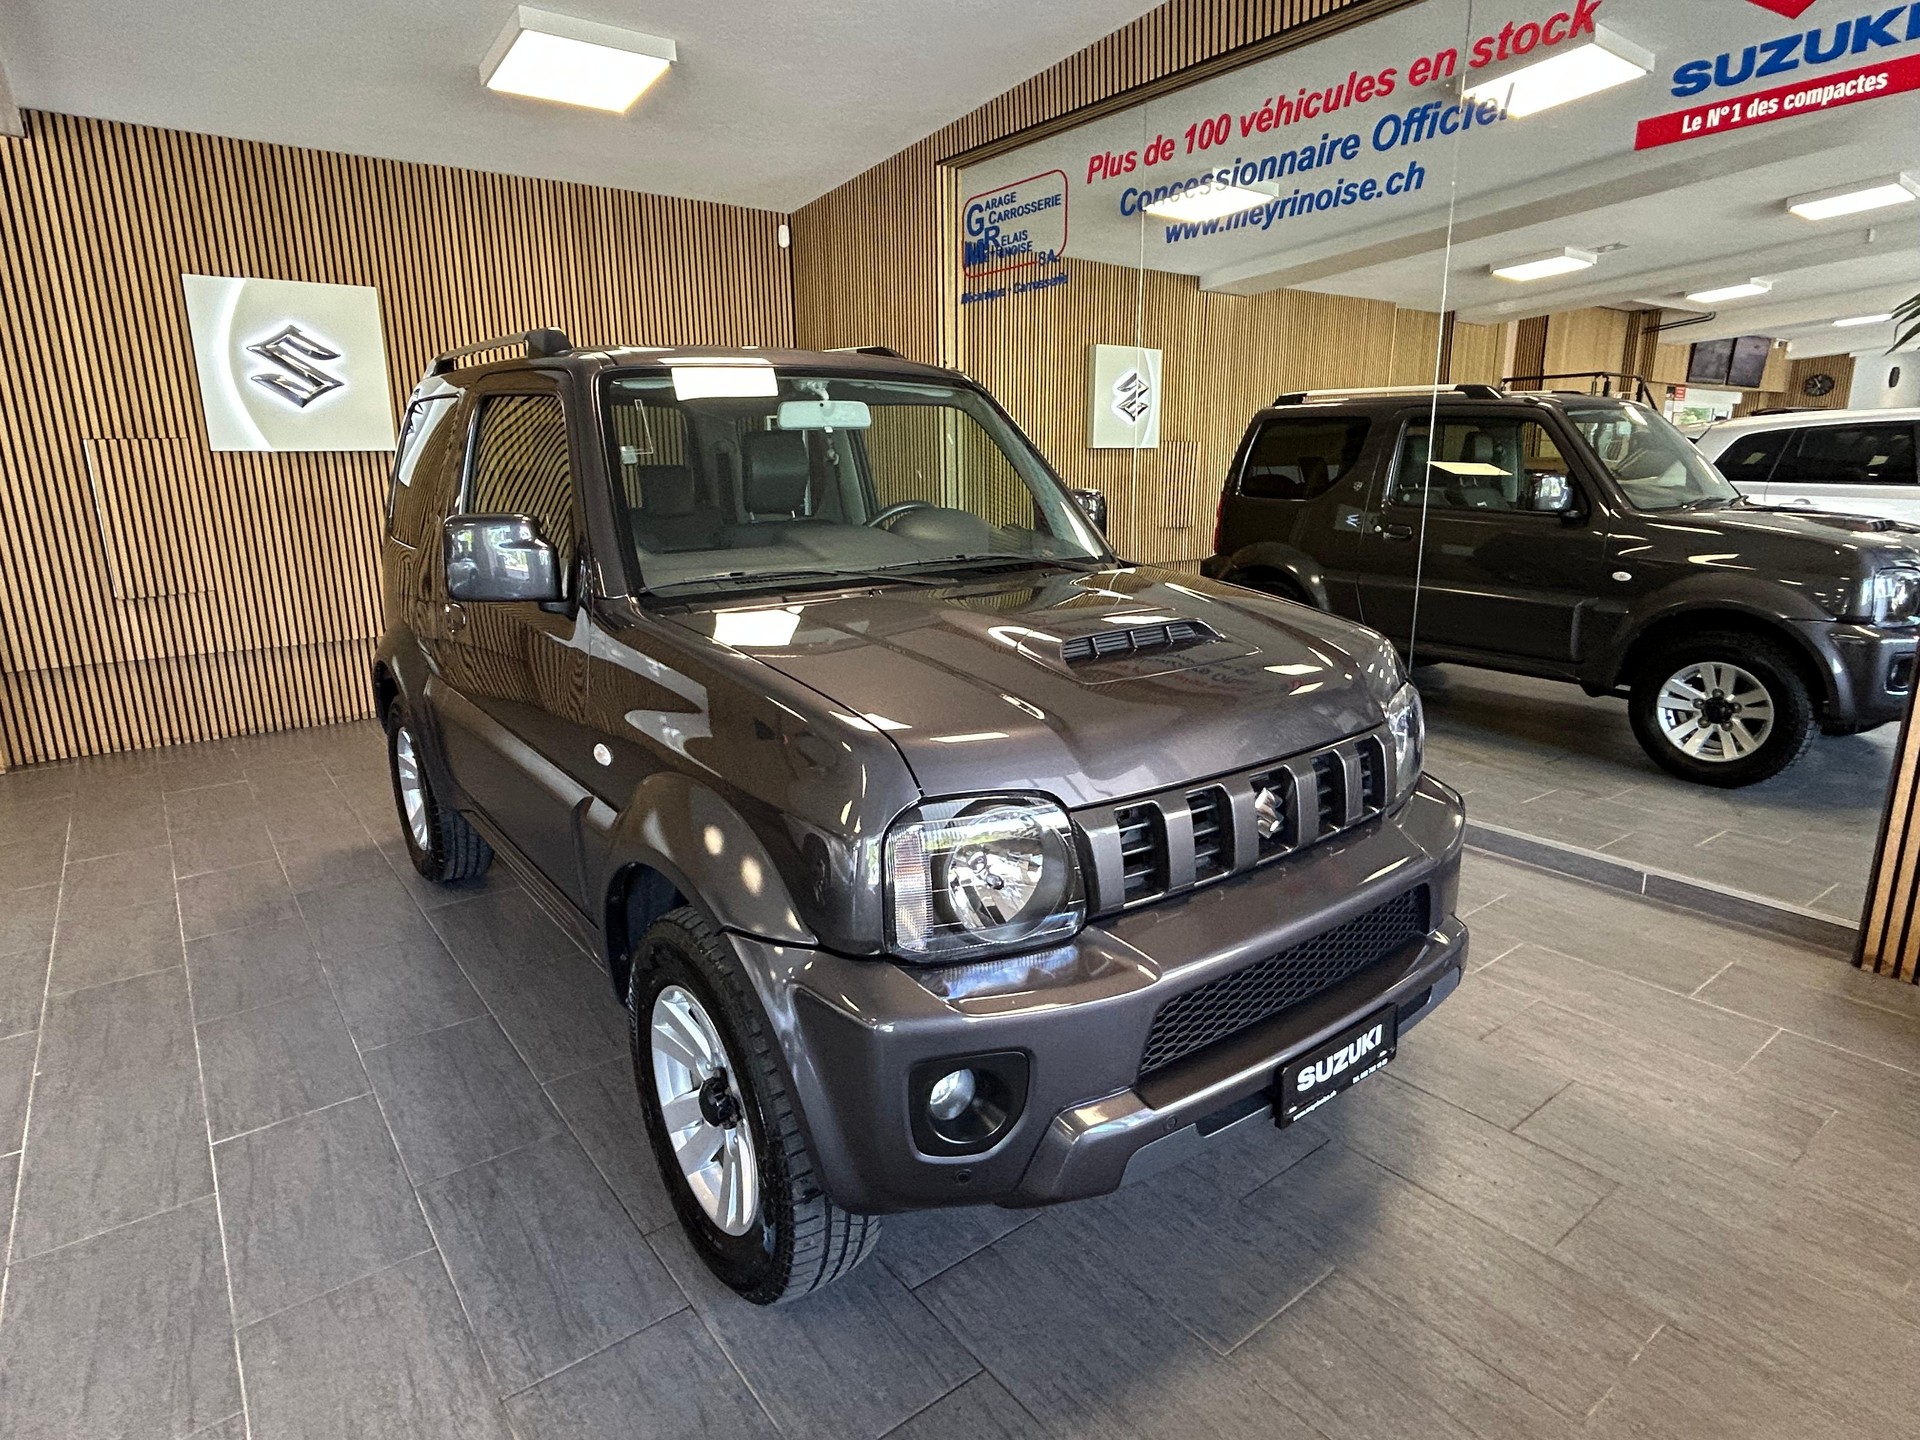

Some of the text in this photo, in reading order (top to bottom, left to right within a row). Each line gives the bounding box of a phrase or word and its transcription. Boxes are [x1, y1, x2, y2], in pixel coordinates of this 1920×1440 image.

[1671, 2, 1920, 98] SUZUKI
[1086, 0, 1602, 185] Plus de 100 véhicules en stock
[1681, 114, 1702, 134] Le
[1746, 97, 1779, 119] des
[1783, 72, 1889, 111] compactes
[1120, 81, 1516, 217] Concessionnaire Officiel
[966, 191, 1017, 237] GARAGE
[988, 193, 1062, 225] CARROSSERIE
[1165, 160, 1426, 244] www.meyrinoise.ch
[984, 225, 1029, 250] RELAIS
[1296, 1023, 1383, 1092] SUZUKI
